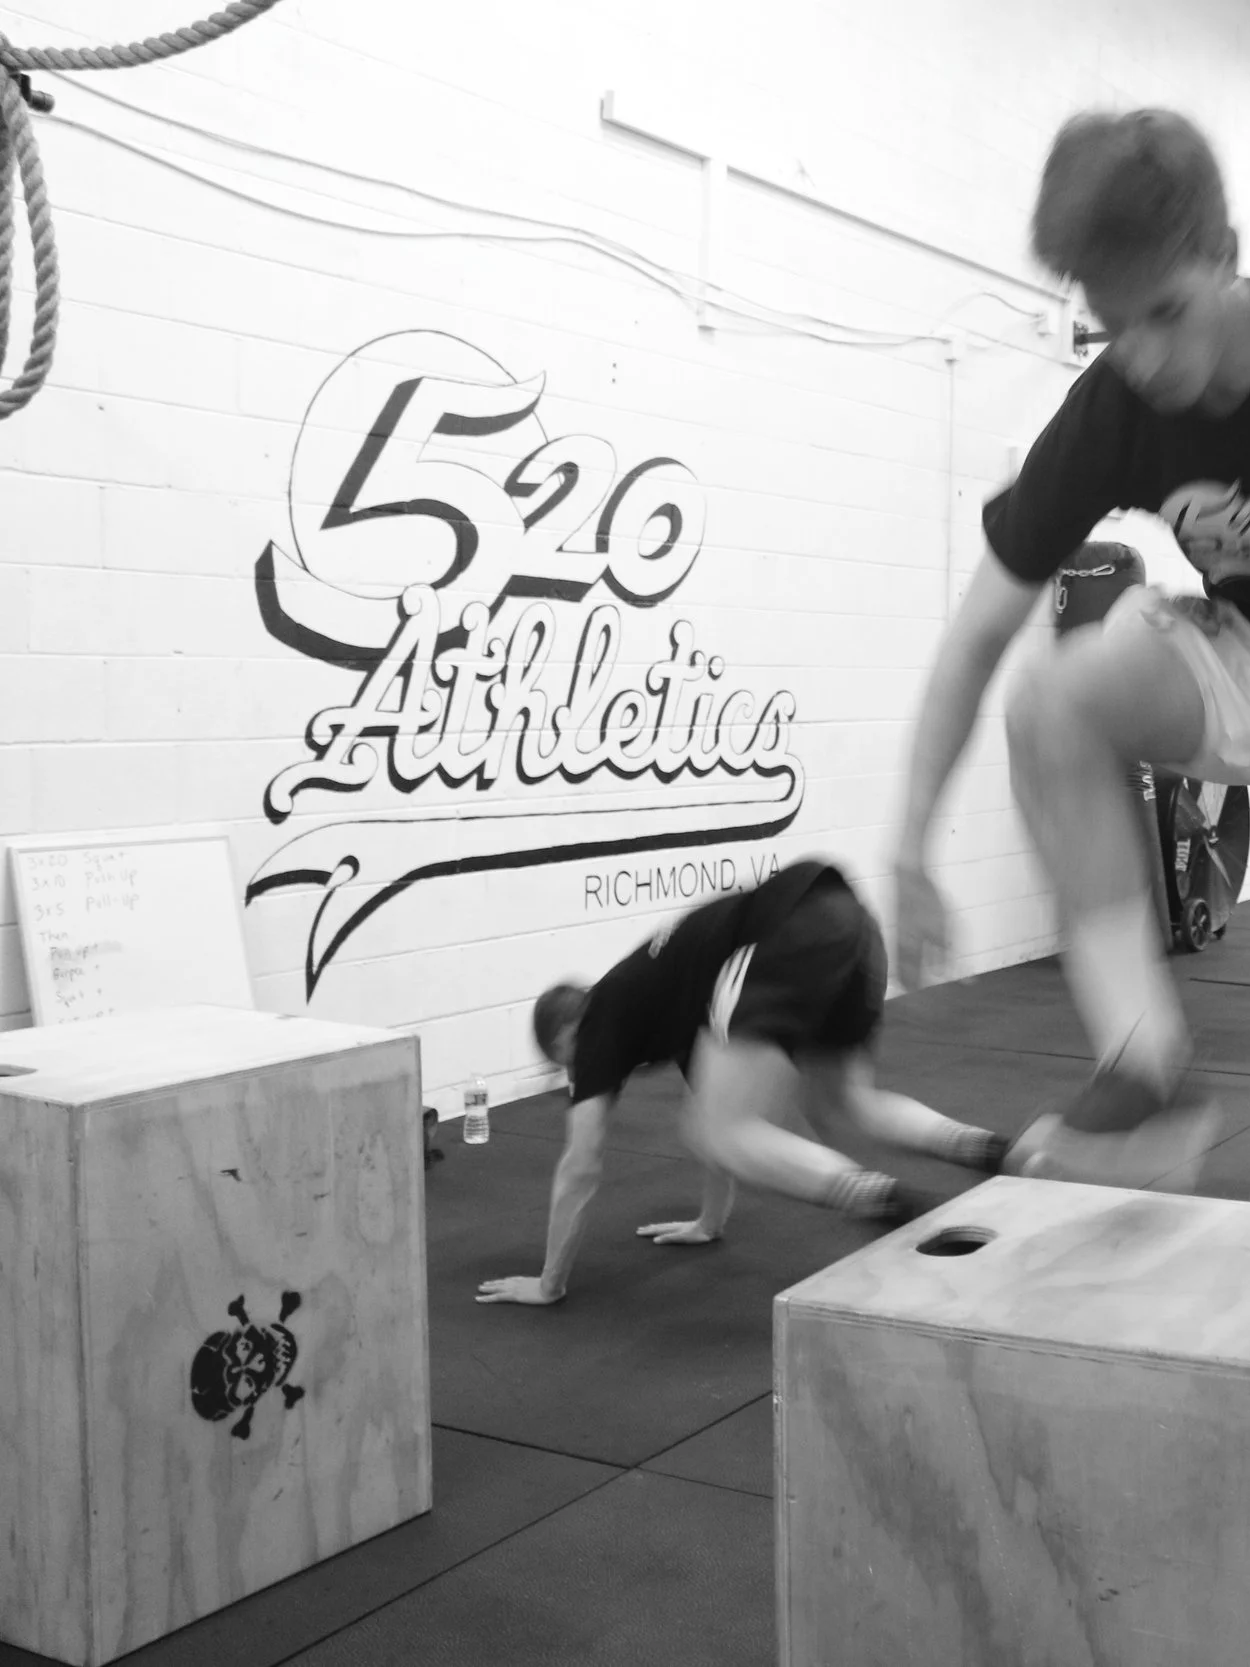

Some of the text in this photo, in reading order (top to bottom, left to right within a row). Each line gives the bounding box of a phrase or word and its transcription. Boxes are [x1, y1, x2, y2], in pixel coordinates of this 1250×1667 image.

[254, 369, 707, 669] 520
[265, 584, 797, 823] Athletics
[583, 853, 781, 910] RICHMOND, VA
